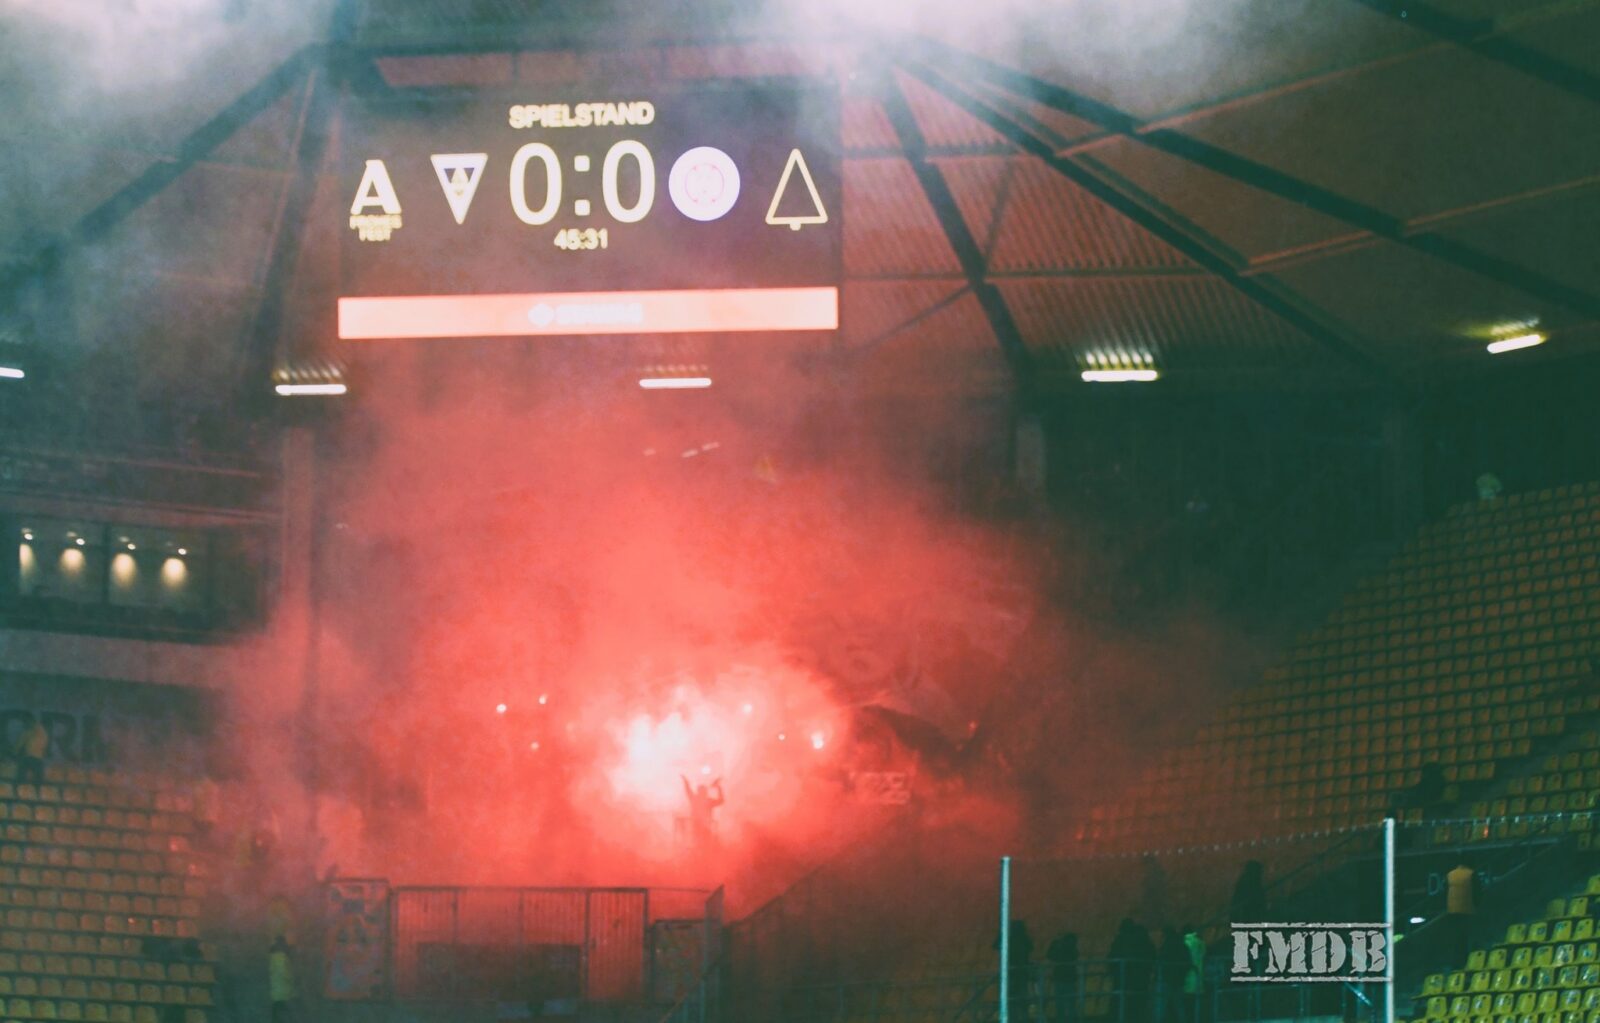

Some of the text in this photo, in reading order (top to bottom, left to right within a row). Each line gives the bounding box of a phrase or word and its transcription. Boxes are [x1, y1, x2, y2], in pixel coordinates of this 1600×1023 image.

[508, 101, 655, 129] SPIELSTAND
[509, 139, 656, 226] 0:0
[553, 227, 608, 250] 45:31
